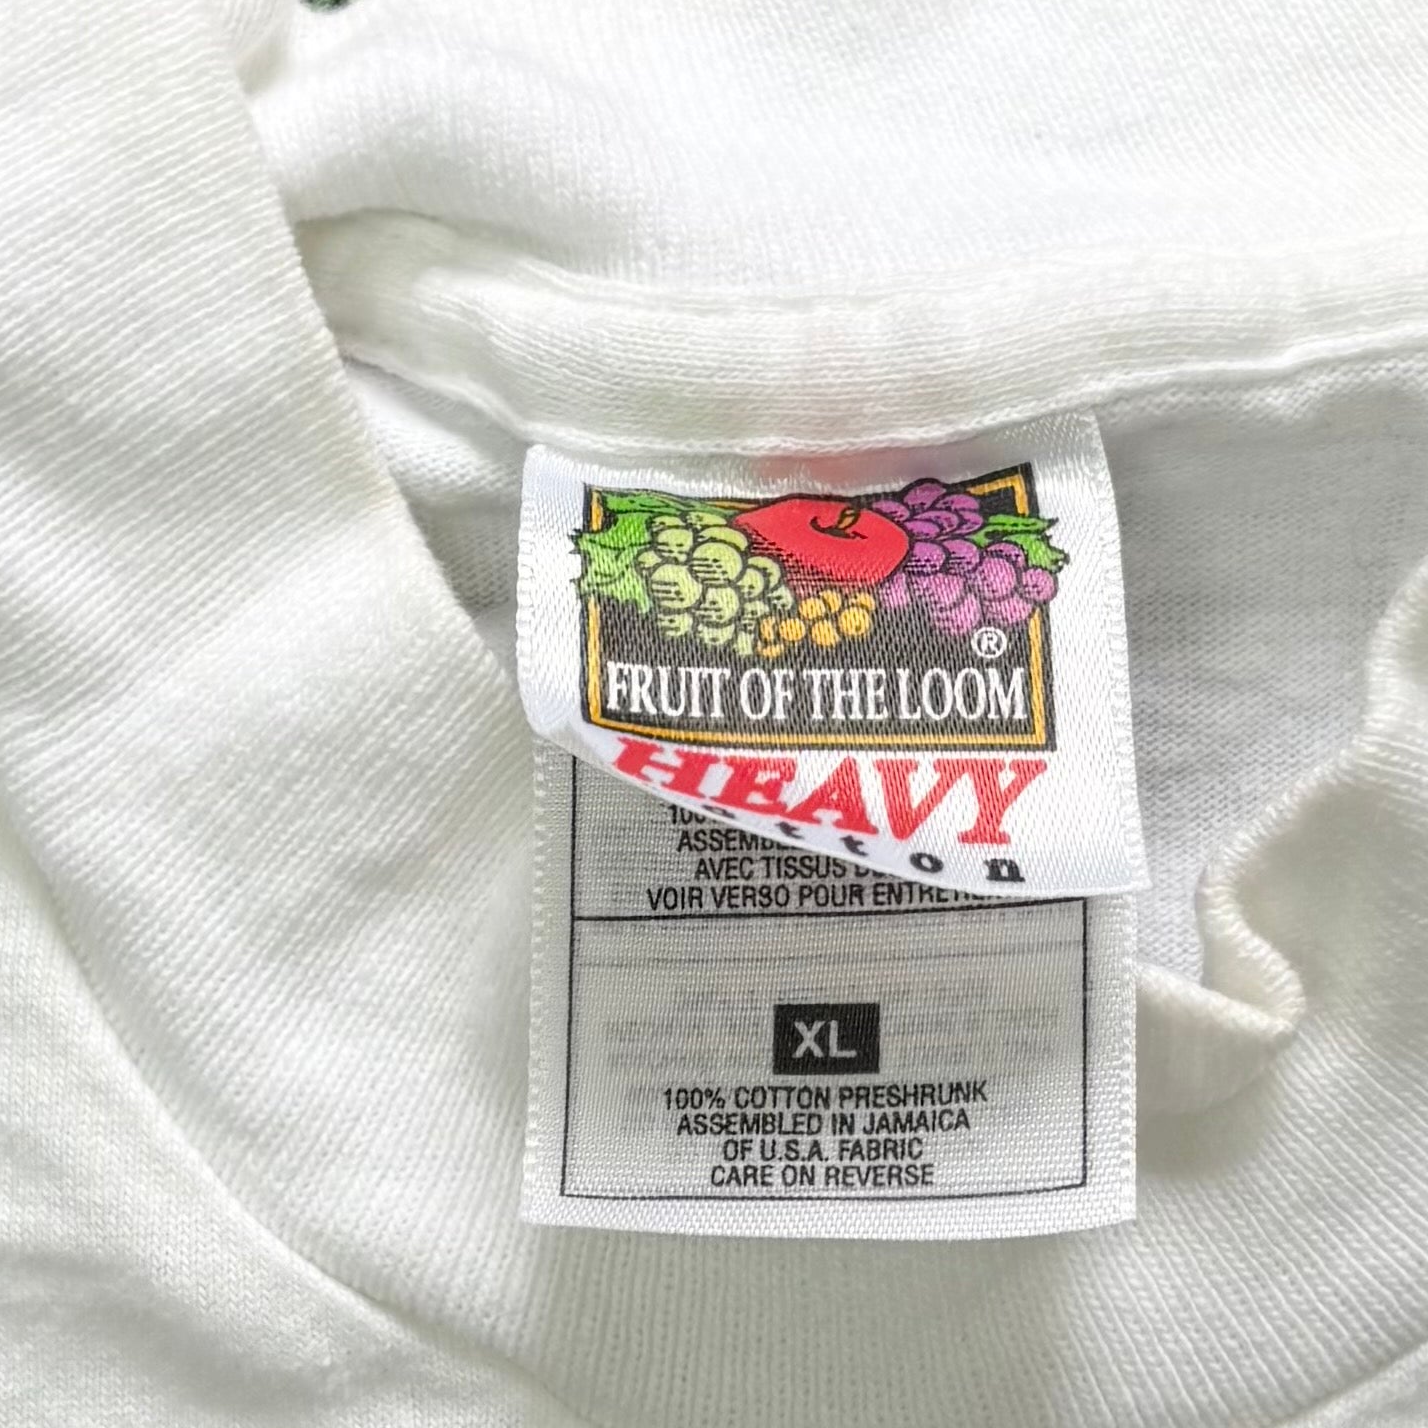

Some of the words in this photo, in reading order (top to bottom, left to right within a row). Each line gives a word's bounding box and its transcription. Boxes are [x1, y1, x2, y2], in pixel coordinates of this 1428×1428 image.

[606, 661, 731, 719] FRUIT
[739, 666, 794, 720] OF
[803, 666, 888, 720] THE
[899, 666, 1029, 720] LOOM
[613, 736, 1047, 845] HEAVY
[702, 804, 1025, 883] otton
[694, 856, 754, 880] AVEC
[761, 855, 847, 879] TISSUS
[646, 886, 704, 911] VOIR
[710, 884, 790, 908] VERSO
[798, 883, 864, 907] POUR
[791, 1019, 857, 1059] XL
[663, 1087, 726, 1110] 100%
[734, 1085, 831, 1110] COTTON
[838, 1079, 988, 1109] PRESHRUNK
[677, 1112, 822, 1136] ASSEMBLED
[832, 1112, 855, 1136] IN
[863, 1108, 971, 1136] JAMAICA
[723, 1138, 753, 1162] OF
[760, 1138, 829, 1162] U.S.A.
[838, 1137, 923, 1161] FABRIC
[710, 1164, 774, 1188] CARE
[781, 1164, 815, 1188] ON
[825, 1163, 934, 1187] REVERSE
